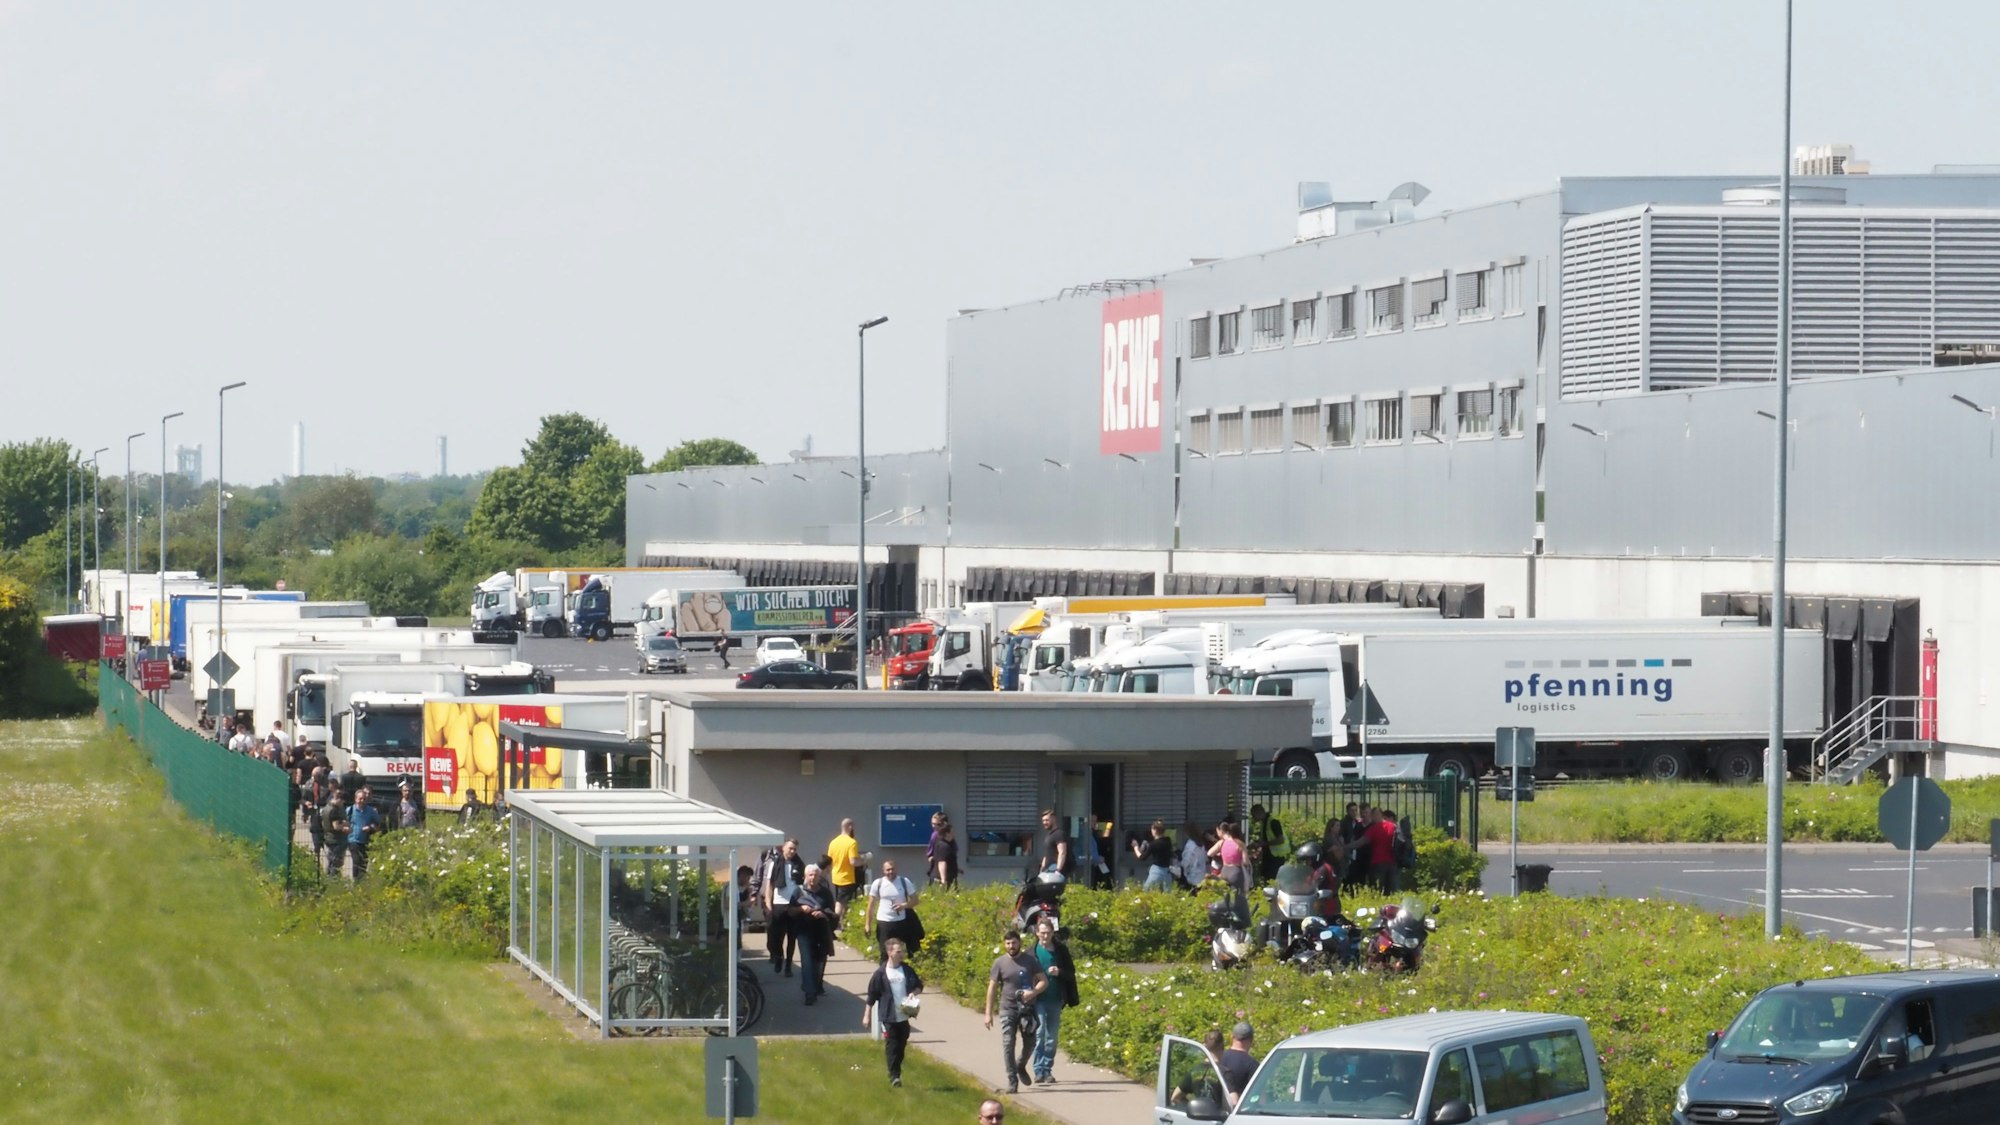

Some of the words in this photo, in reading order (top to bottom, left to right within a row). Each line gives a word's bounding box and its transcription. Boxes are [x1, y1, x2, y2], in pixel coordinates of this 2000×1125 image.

[1103, 314, 1160, 432] REWE
[736, 593, 759, 611] WIR
[765, 591, 809, 610] SUCHEN
[815, 590, 850, 608] DICH!
[1505, 673, 1672, 702] pfenning
[1517, 702, 1576, 713] logistics
[387, 762, 422, 773] REWE
[430, 757, 452, 773] REWE
